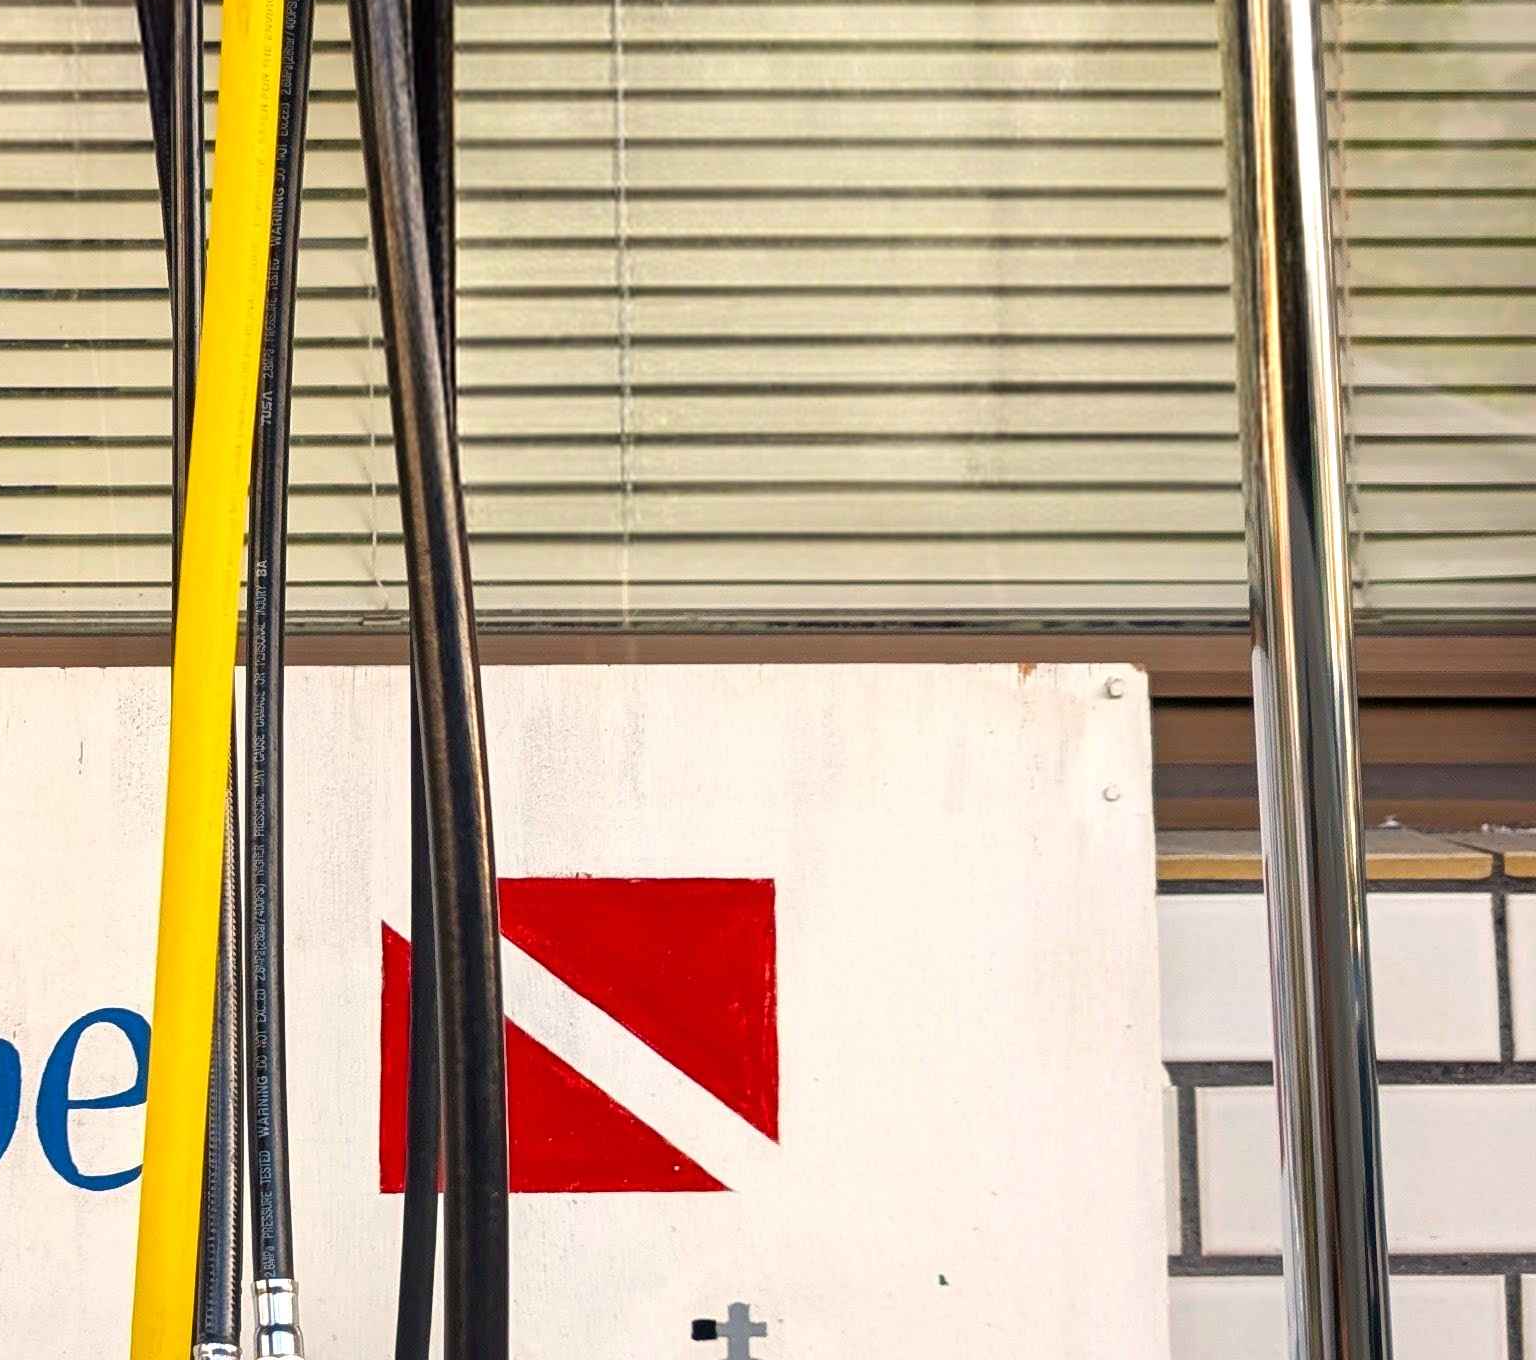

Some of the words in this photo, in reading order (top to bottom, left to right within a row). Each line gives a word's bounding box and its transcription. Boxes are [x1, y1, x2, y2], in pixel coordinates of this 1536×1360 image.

[260, 391, 273, 426] TUSA
[270, 187, 285, 246] WARNING
[255, 584, 267, 615] INJURY
[253, 733, 265, 762] CAUSE
[254, 769, 265, 787] MAY
[254, 792, 265, 837] PRESSURE
[256, 1076, 270, 1137] WARNING
[258, 1150, 271, 1185] TESTED
[260, 1190, 274, 1239] PRESSURE
